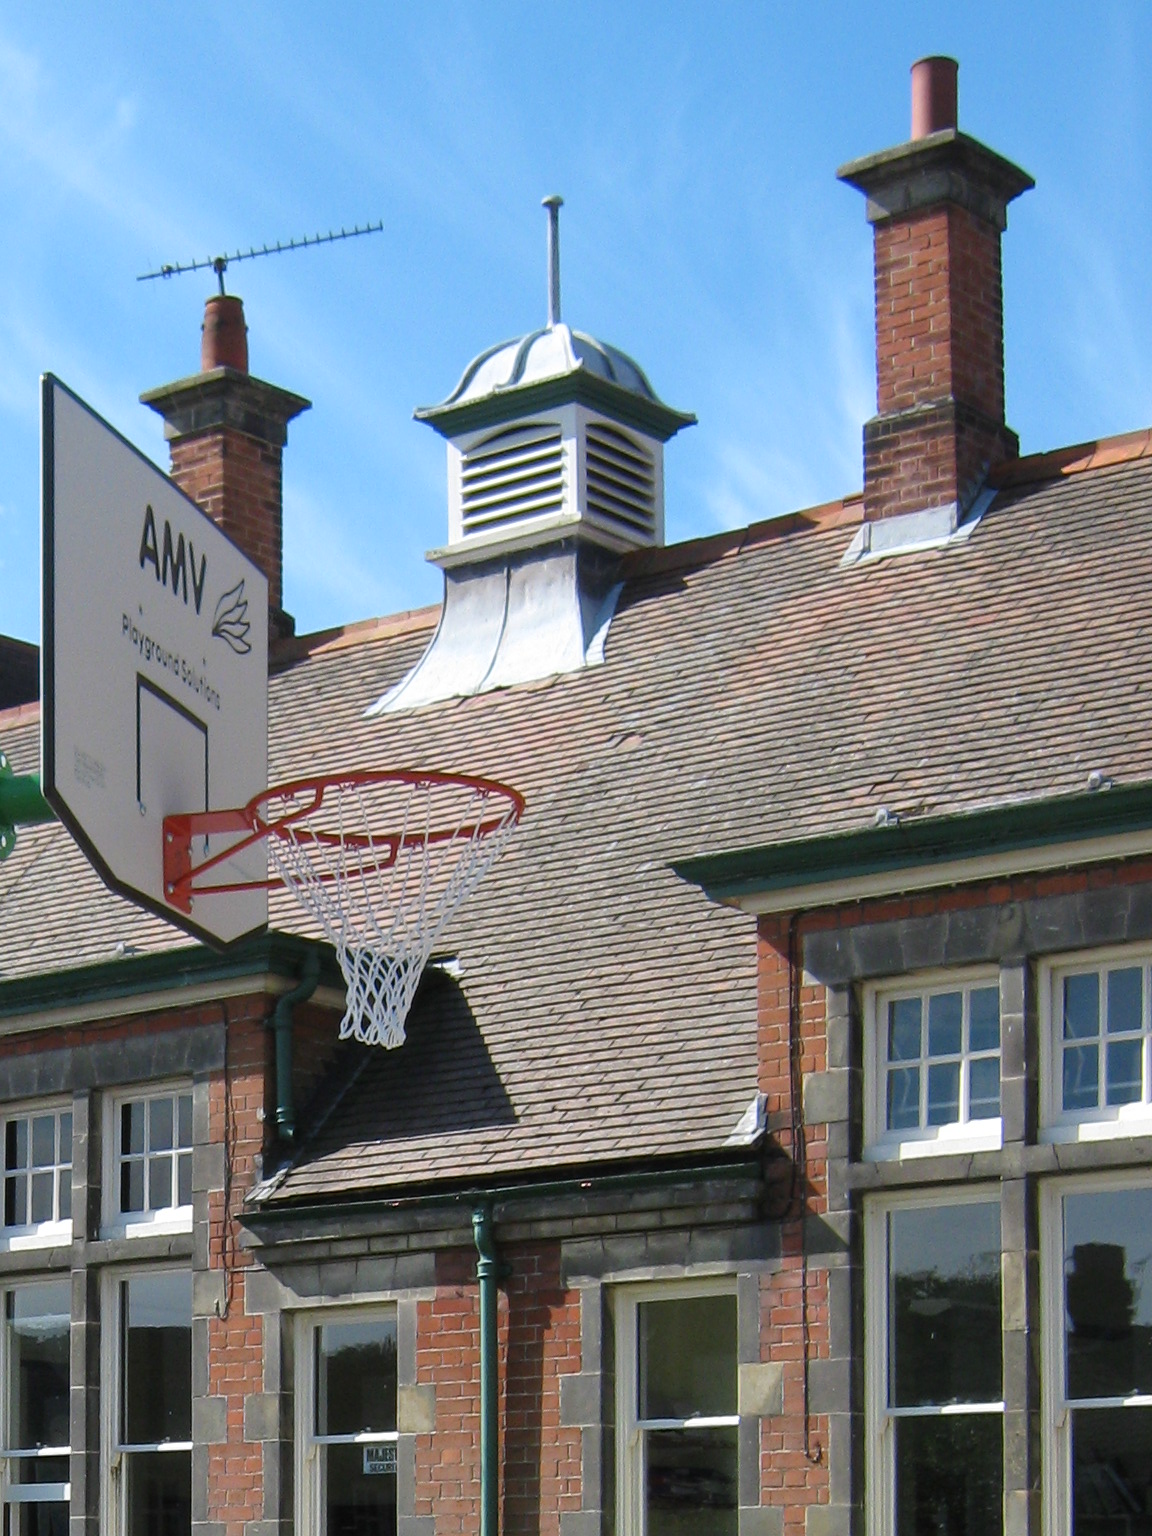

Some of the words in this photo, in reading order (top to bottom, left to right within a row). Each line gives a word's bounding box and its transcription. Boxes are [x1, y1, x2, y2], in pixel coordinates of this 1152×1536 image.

[139, 503, 207, 616] AMV
[122, 612, 180, 676] Playground
[181, 659, 221, 711] Solutions
